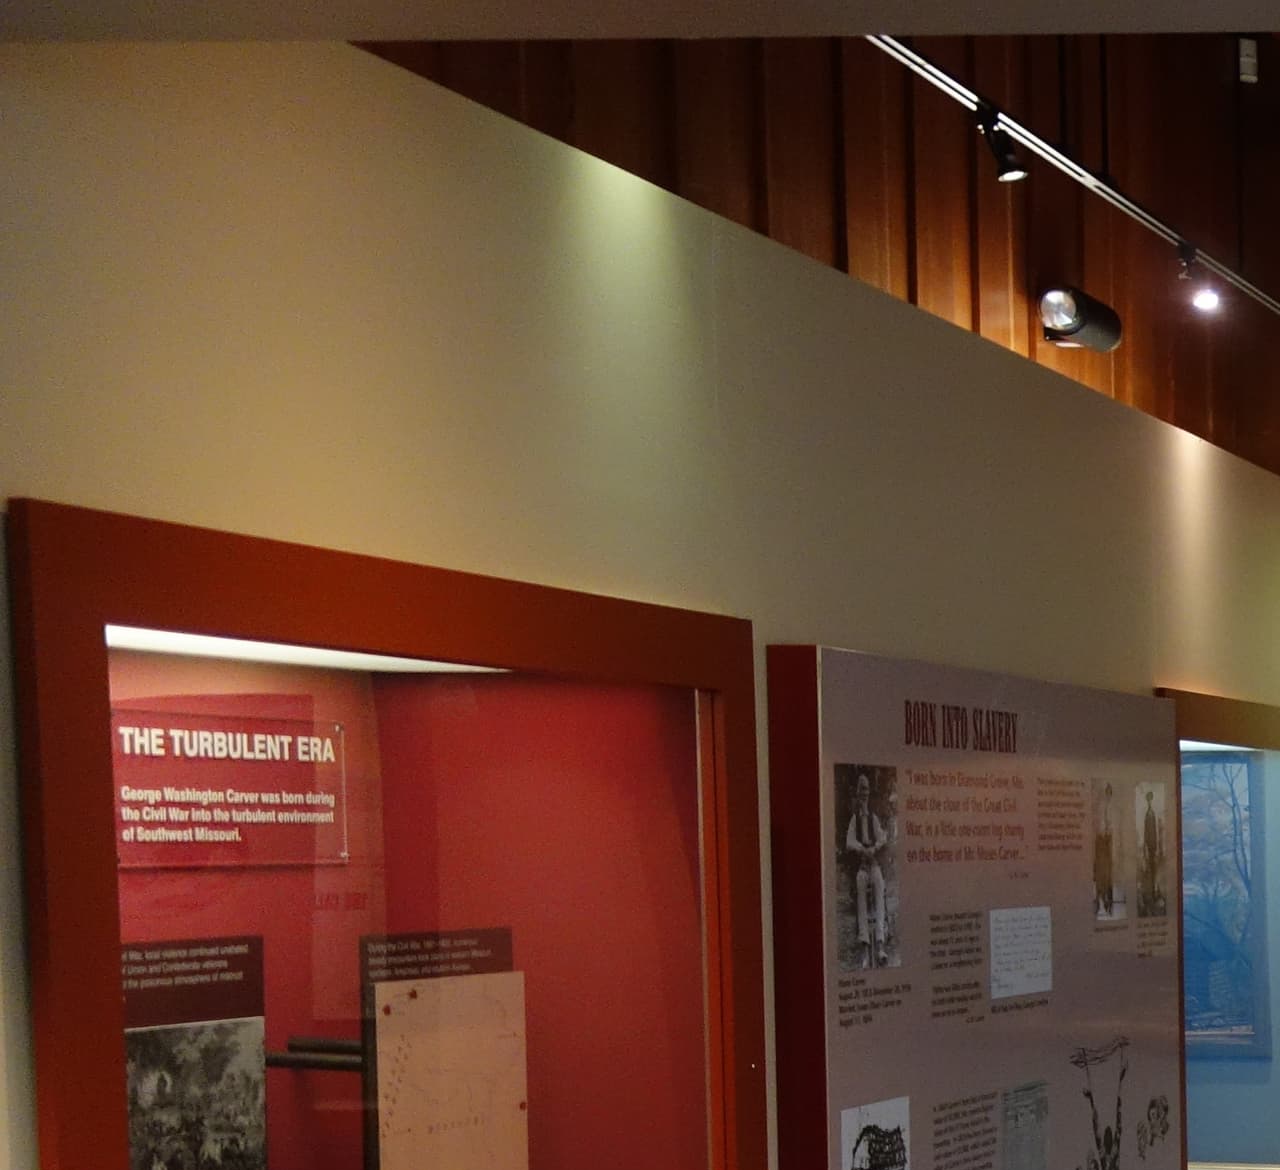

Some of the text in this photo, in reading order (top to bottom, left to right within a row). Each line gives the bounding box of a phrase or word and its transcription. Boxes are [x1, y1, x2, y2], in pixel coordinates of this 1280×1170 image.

[905, 700, 1018, 753] BORN INTO SLAVERY
[118, 726, 335, 763] THE TURBULENT ERA
[121, 786, 335, 808] George Washington Carver was born during
[122, 807, 334, 824] the Civil War into the turbulent environment
[122, 827, 241, 842] of Southwest Missouri.
